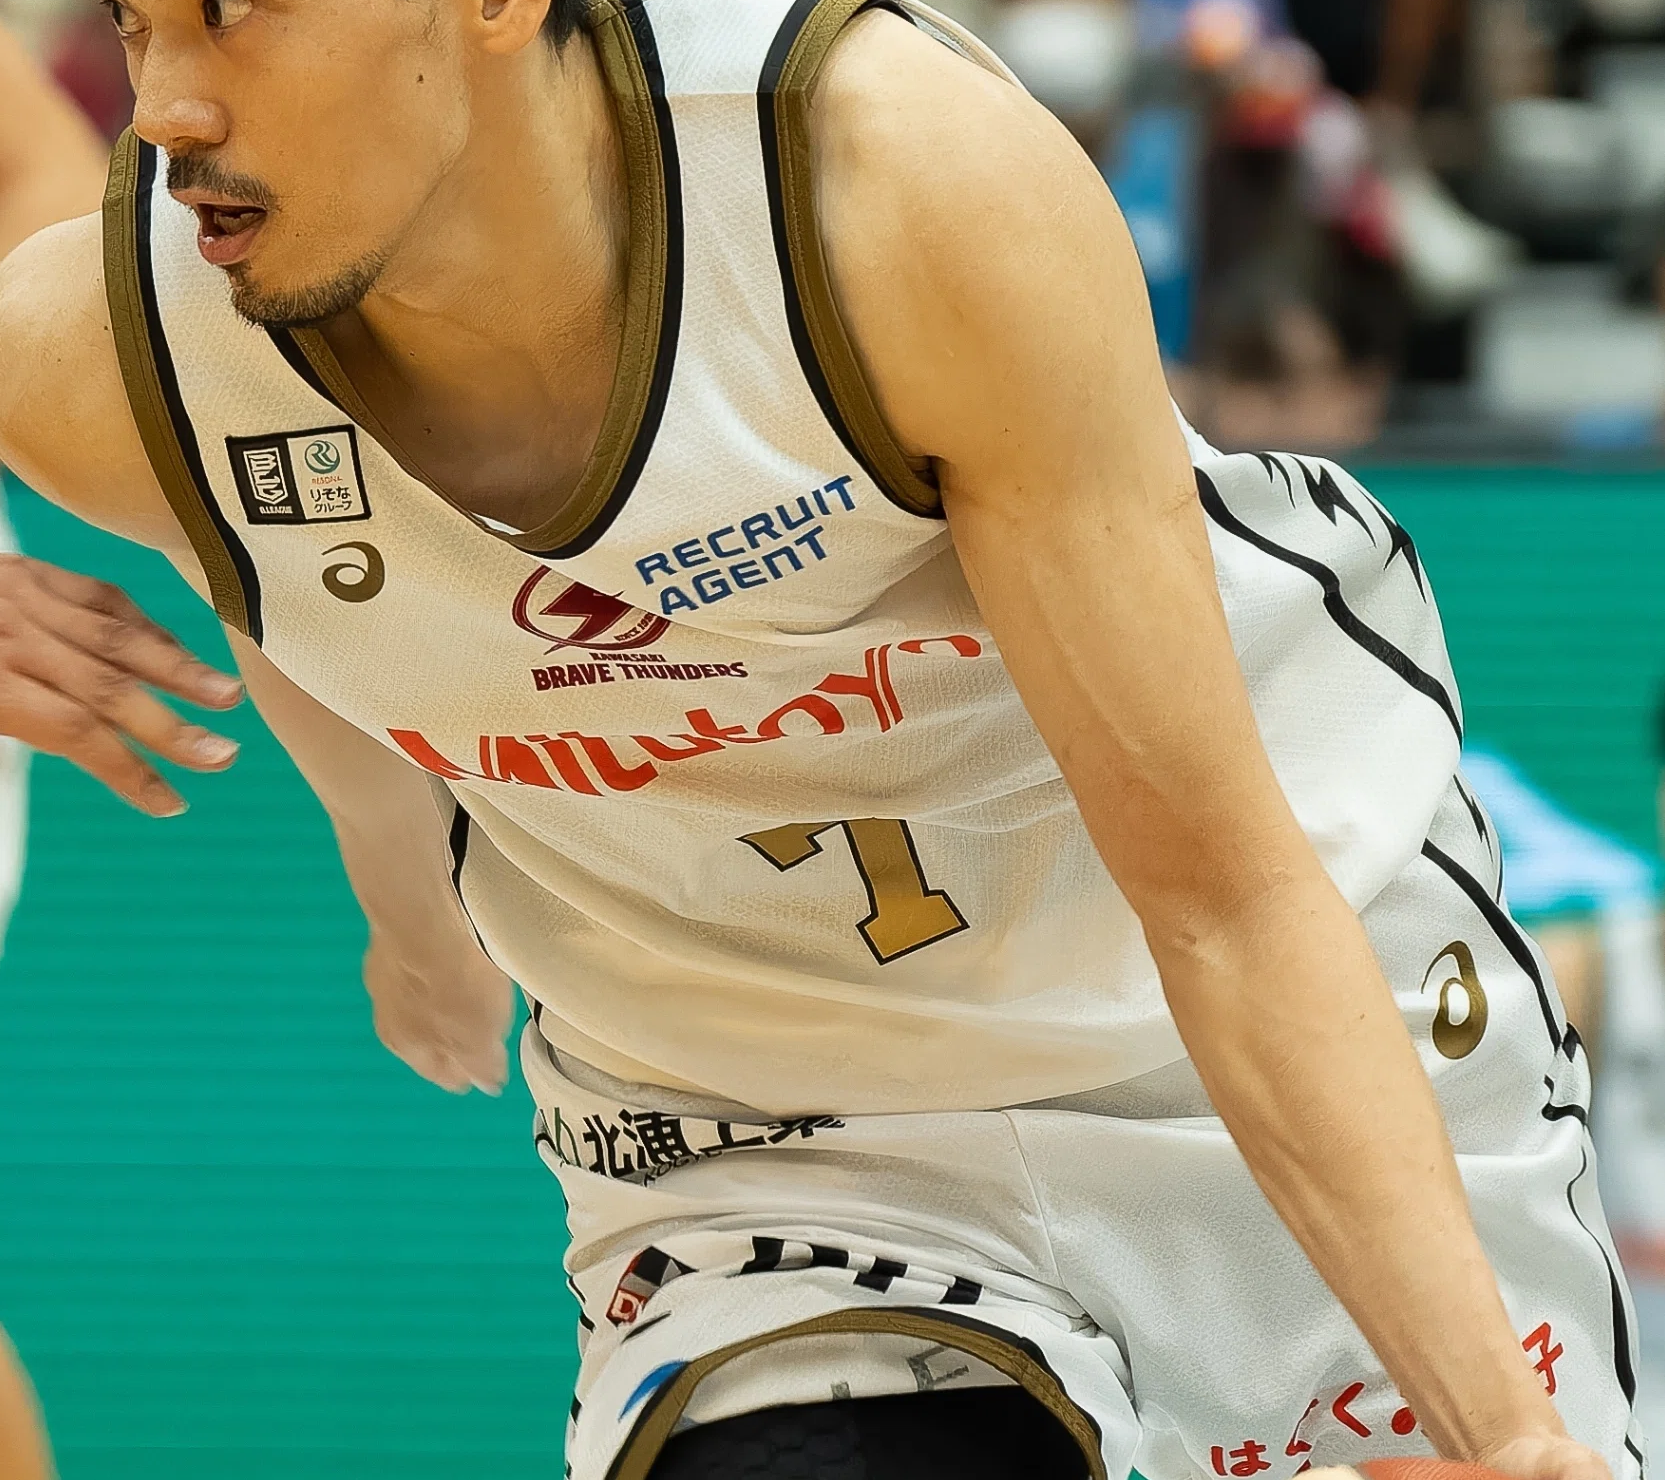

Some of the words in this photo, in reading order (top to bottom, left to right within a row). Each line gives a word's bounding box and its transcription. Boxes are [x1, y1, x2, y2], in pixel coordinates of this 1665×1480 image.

[309, 485, 352, 503] りそな
[313, 500, 353, 514] グループ
[634, 474, 857, 586] RECRUIT
[659, 524, 828, 616] AGENT
[530, 662, 616, 692] BRAVE
[616, 661, 750, 682] THUNDERS
[734, 817, 970, 966] 7
